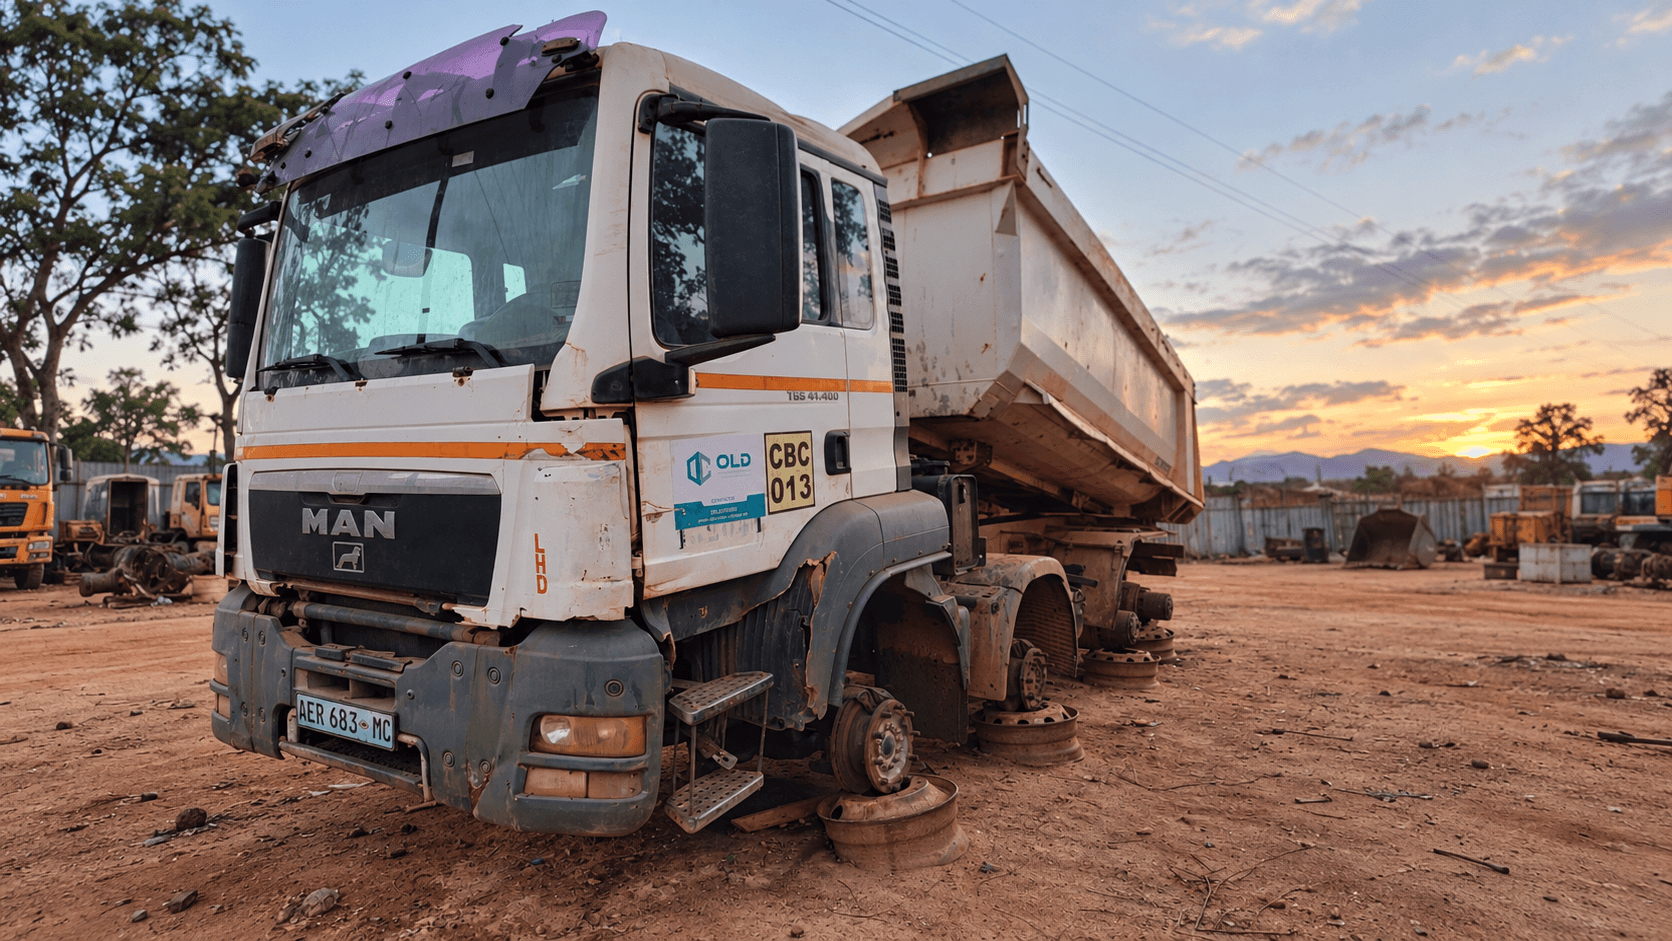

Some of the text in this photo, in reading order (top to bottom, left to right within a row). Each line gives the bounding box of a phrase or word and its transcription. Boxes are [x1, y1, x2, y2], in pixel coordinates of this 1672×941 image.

[808, 391, 839, 401] 41.400
[716, 453, 751, 469] OLD
[769, 441, 810, 469] CBC
[771, 474, 811, 504] 013
[301, 507, 396, 540] MAN
[533, 533, 548, 594] LHD
[299, 699, 391, 742] AER 683 MC
